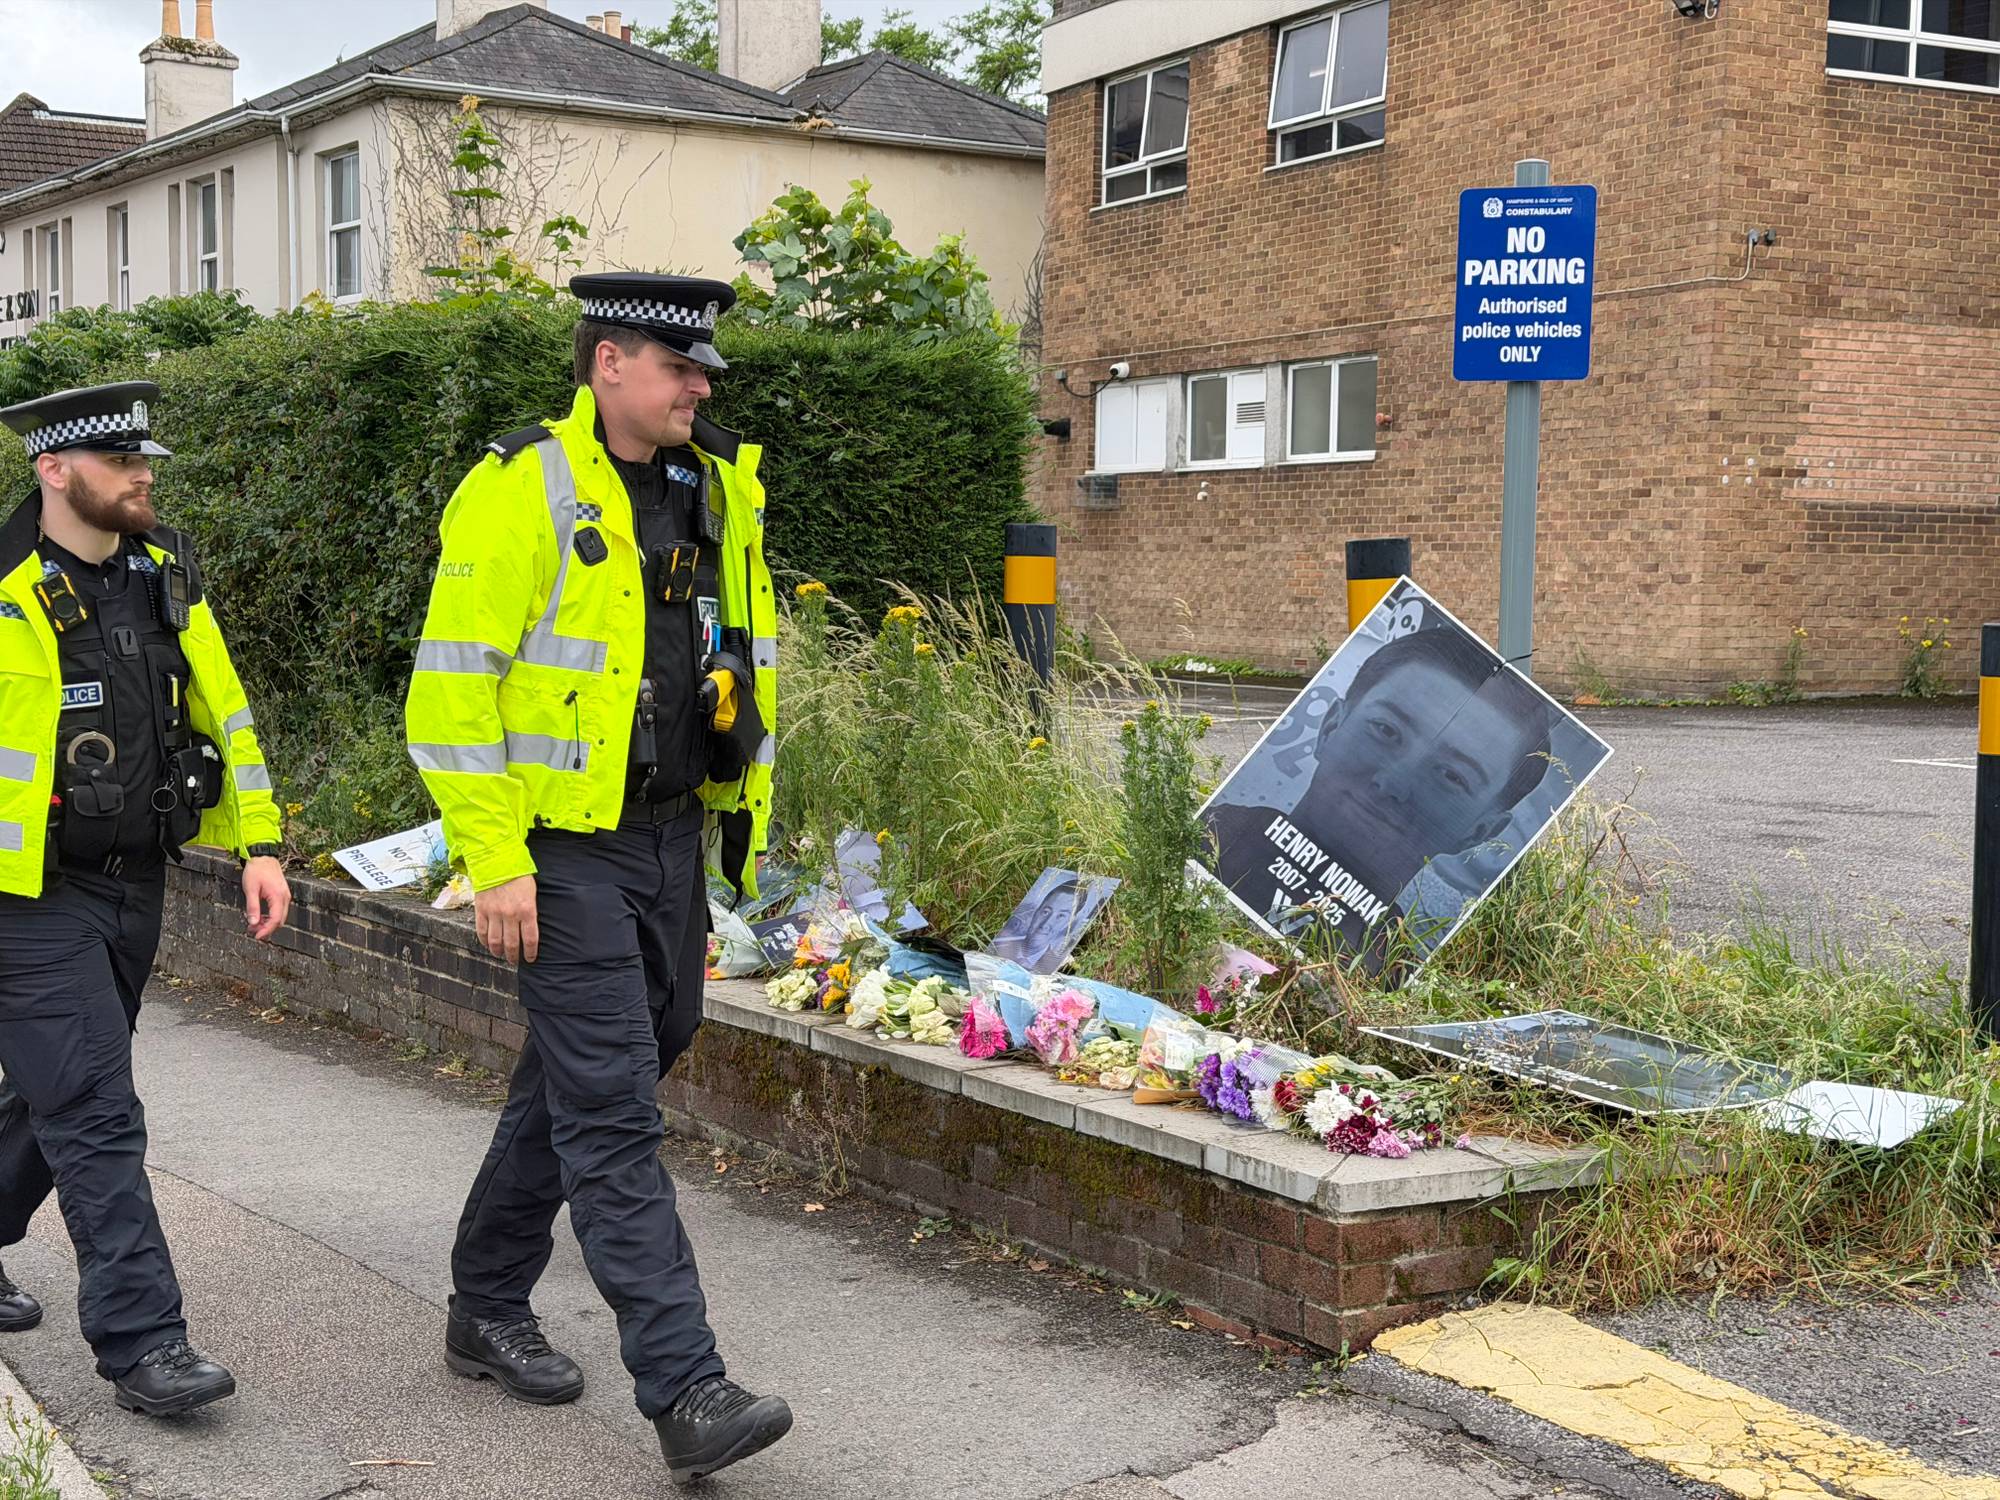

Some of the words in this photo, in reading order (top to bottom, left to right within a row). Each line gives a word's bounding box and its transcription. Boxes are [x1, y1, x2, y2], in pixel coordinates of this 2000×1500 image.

[1505, 207, 1573, 216] CONSTABULARY
[1507, 226, 1546, 253] NO
[1464, 258, 1586, 286] PARKING
[1478, 297, 1567, 314] Authorised
[1462, 322, 1511, 342] police
[1515, 321, 1582, 338] vehicles
[1500, 346, 1541, 363] ONLY
[440, 562, 475, 577] POLICE
[388, 847, 413, 862] NOT
[1264, 815, 1329, 873] HENRY
[1318, 862, 1389, 926] NOWAK
[1268, 856, 1307, 891] 2007
